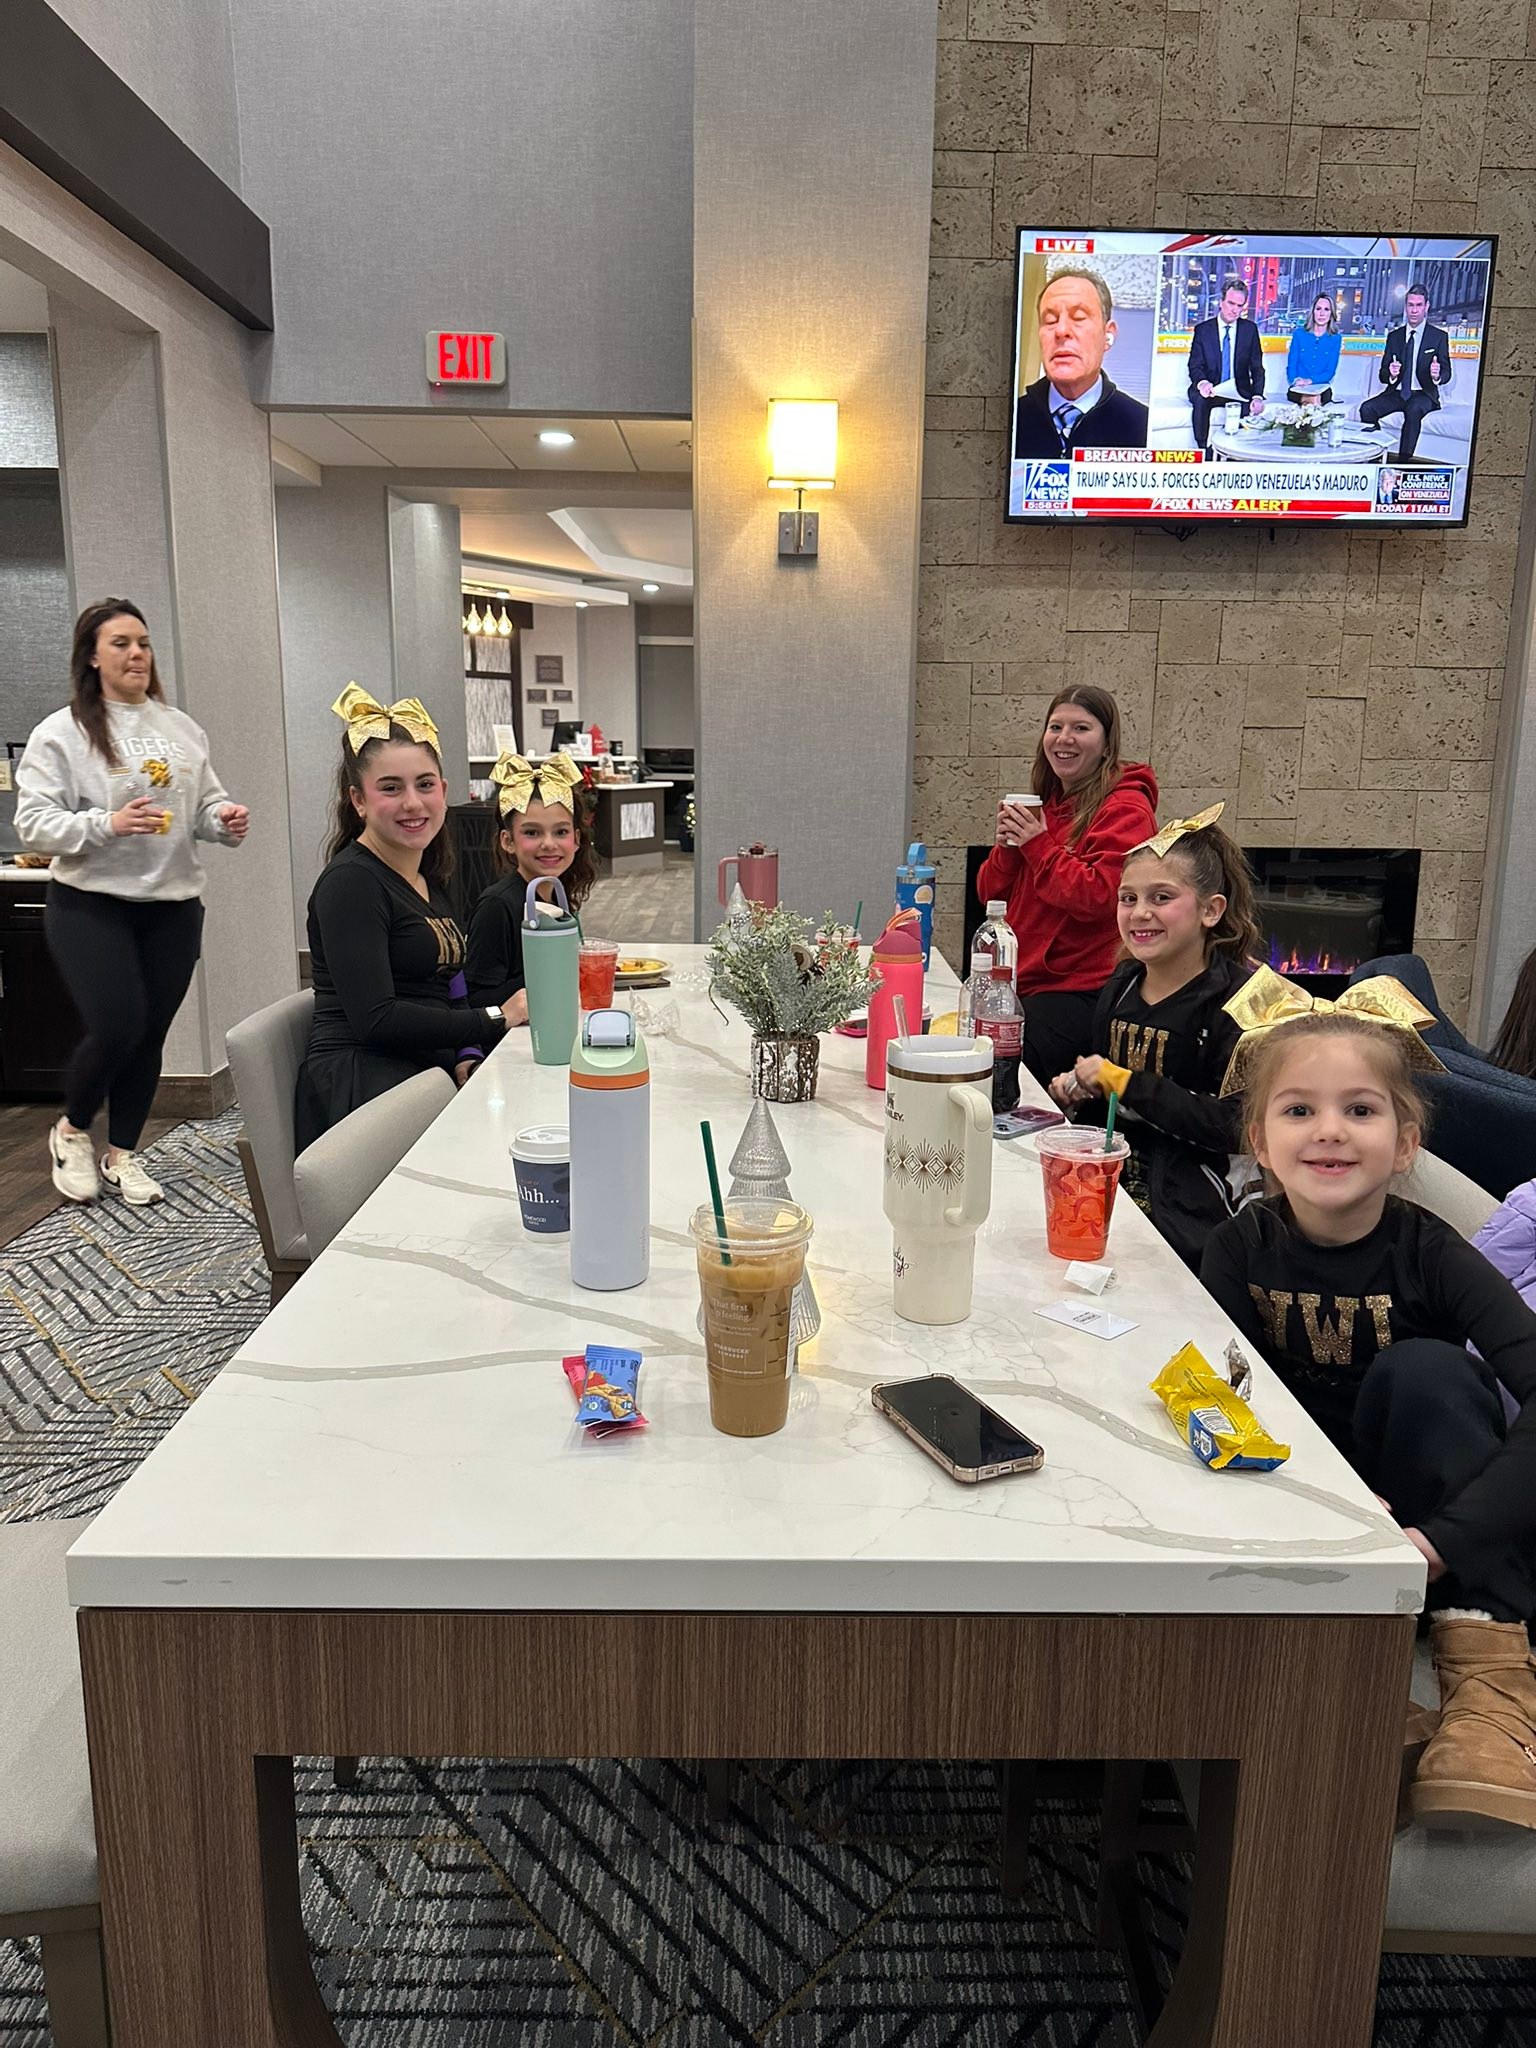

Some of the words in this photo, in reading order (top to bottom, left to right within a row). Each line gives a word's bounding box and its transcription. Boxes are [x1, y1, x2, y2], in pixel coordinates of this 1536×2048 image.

[1042, 239, 1088, 252] LIVE
[438, 333, 495, 381] EXIT
[1084, 449, 1153, 463] BREAKING
[1155, 450, 1196, 463] NEWS
[1040, 472, 1068, 487] FOX
[1076, 471, 1110, 488] TRUMP
[1112, 471, 1138, 489] SAYS
[1140, 471, 1160, 489] U.S.
[1162, 472, 1200, 489] FORCES
[1202, 472, 1253, 490] CAPTURED
[1255, 473, 1321, 491] VENEZUELA'S
[1322, 473, 1369, 492] MADURO
[1406, 473, 1422, 482] U.S.
[1423, 474, 1446, 483] NEWS
[1402, 481, 1449, 490] CONFERENCE
[1030, 486, 1069, 500] NEWS
[1401, 490, 1412, 498] ON
[1413, 490, 1448, 499] VENEZUELA
[1027, 501, 1053, 510] 5:58
[1054, 501, 1065, 510] CT
[1161, 498, 1191, 511] FOX
[1191, 498, 1234, 511] NEWS
[1234, 498, 1292, 512] ALERT
[1376, 504, 1407, 513] TODAY
[1411, 504, 1437, 513] 11AM
[1439, 505, 1450, 513] ET
[731, 1301, 749, 1312] first
